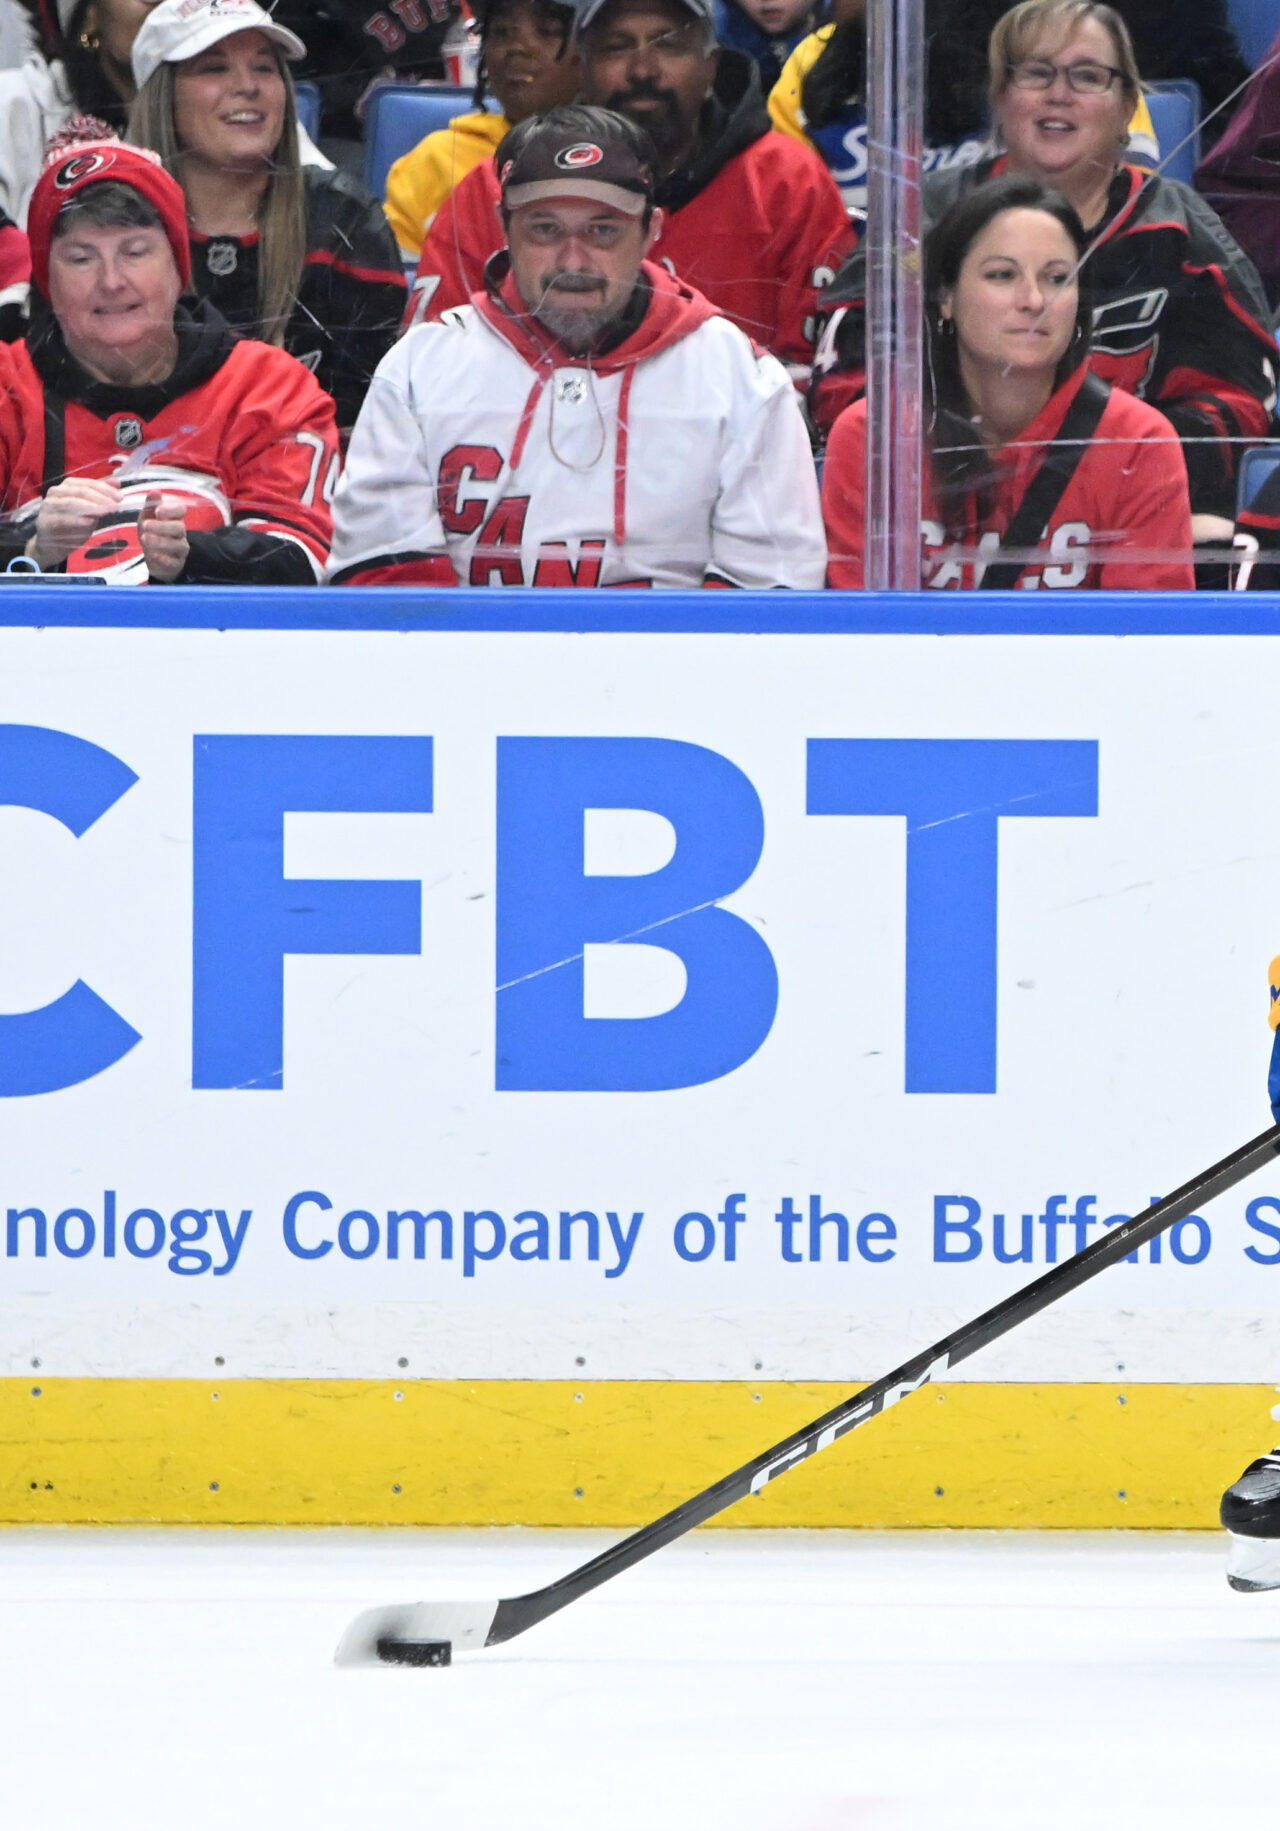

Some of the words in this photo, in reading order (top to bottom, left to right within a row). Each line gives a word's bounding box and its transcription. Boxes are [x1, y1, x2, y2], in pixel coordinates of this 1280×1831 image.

[5, 1189, 253, 1276] nology
[282, 1190, 645, 1279] Company
[673, 1193, 747, 1264] of
[775, 1195, 898, 1264] the
